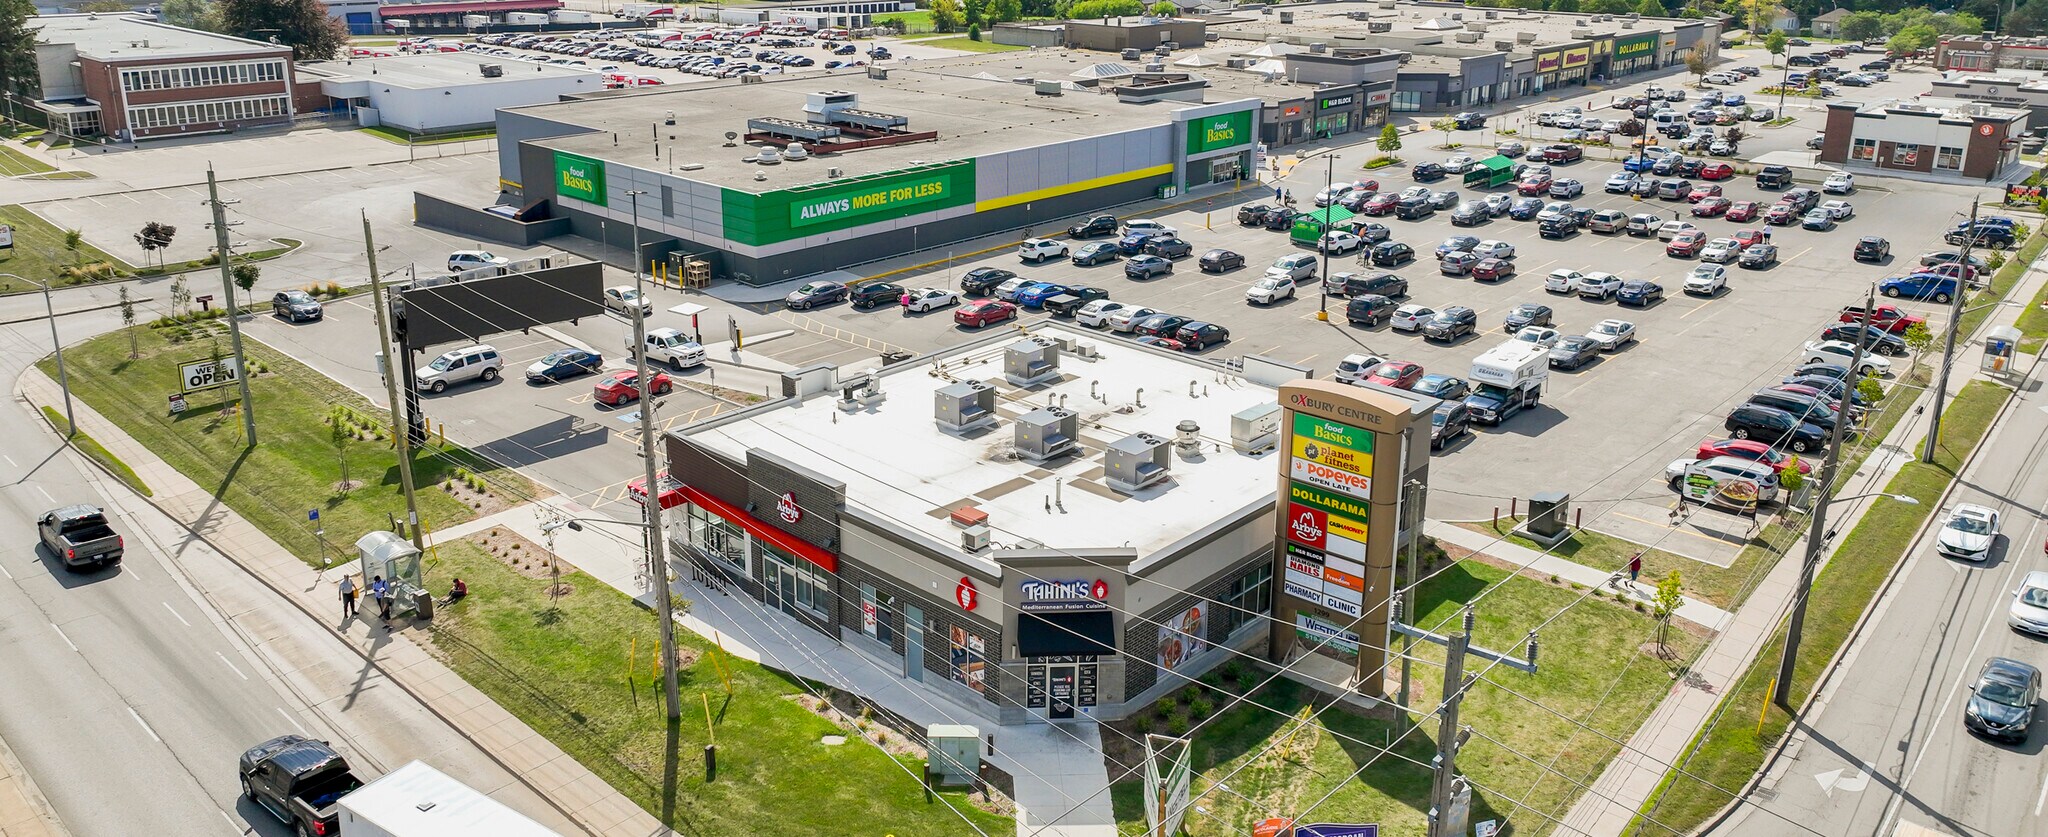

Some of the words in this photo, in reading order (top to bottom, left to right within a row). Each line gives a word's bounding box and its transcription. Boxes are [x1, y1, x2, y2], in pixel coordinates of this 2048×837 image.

[1619, 41, 1649, 55] DOLLARAMA
[1338, 96, 1352, 105] BLOCK
[1214, 121, 1228, 130] food
[1207, 128, 1234, 143] Basics
[570, 166, 584, 178] food
[563, 170, 593, 193] Basics
[801, 198, 850, 220] ALWAYS
[853, 191, 887, 210] MORE
[890, 187, 912, 203] FOR
[915, 181, 943, 198] LESS
[195, 363, 227, 375] WE'RE
[190, 369, 235, 387] OPEN
[1291, 394, 1335, 413] OXBURY
[1337, 405, 1382, 425] CENTRE
[1314, 424, 1353, 446] Basics
[1324, 423, 1343, 433] food
[1320, 446, 1355, 462] planet
[1324, 455, 1360, 473] fitness
[1309, 476, 1330, 487] OPEN
[1332, 482, 1351, 492] LATE
[777, 500, 799, 518] Arby's
[1292, 487, 1367, 518] DOLLARAMA
[1291, 519, 1323, 537] Arby's
[1306, 551, 1323, 561] BLOCK
[1290, 560, 1320, 577] NAILS
[1285, 583, 1320, 601] PHARMACY
[1314, 607, 1330, 618] 1299
[1328, 598, 1356, 614] CLINIC
